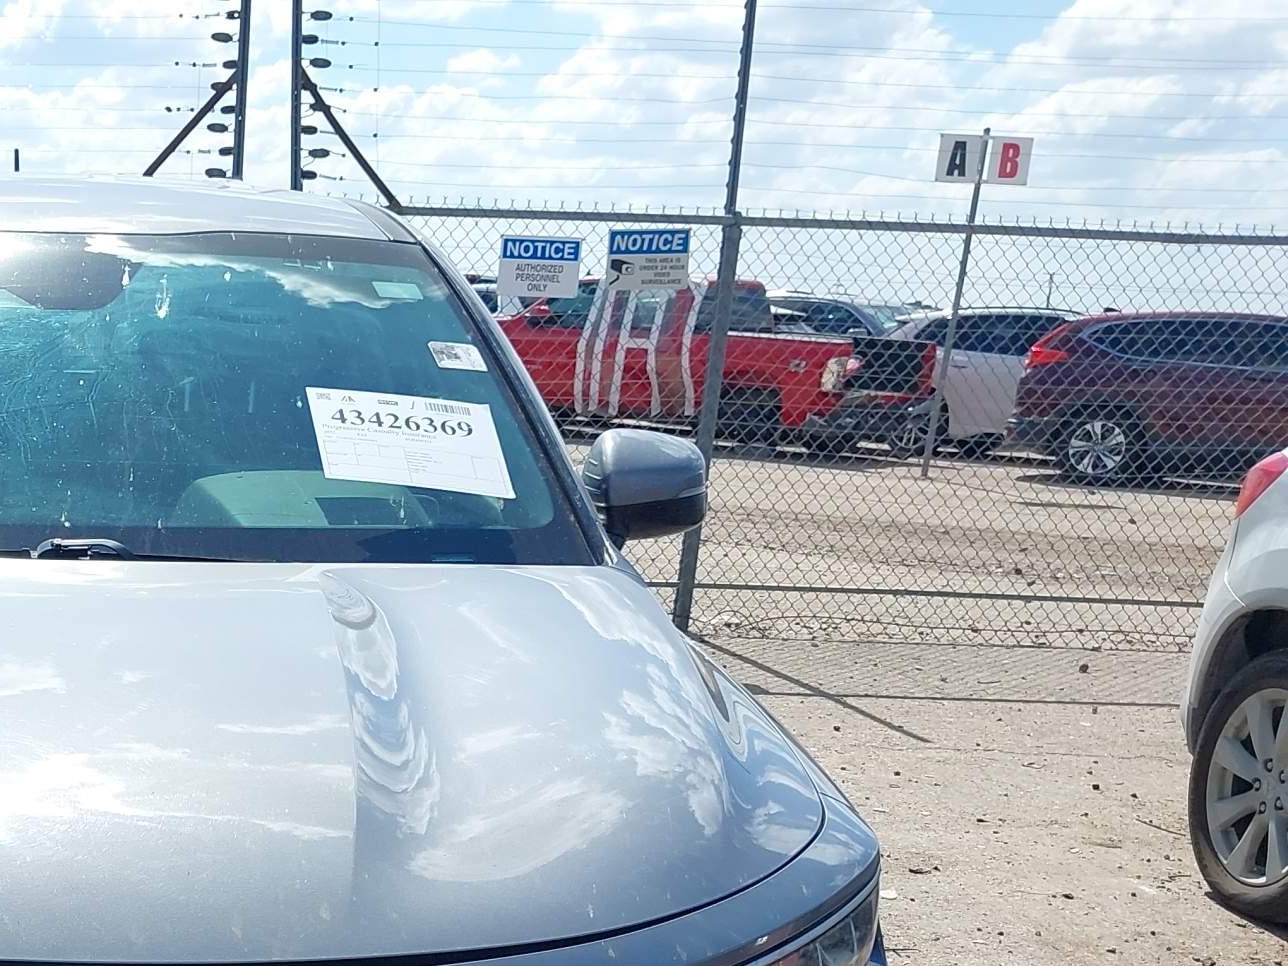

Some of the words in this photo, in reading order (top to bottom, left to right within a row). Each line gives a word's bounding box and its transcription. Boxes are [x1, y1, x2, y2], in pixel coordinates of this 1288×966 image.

[945, 141, 967, 177] A
[998, 142, 1021, 178] B
[506, 241, 577, 259] NOTICE
[612, 233, 686, 251] NOTICE
[515, 263, 564, 274] AUTHORIZED
[515, 273, 561, 283] PERSONNEL
[527, 282, 548, 292] ONLY
[330, 408, 473, 438] 43426369
